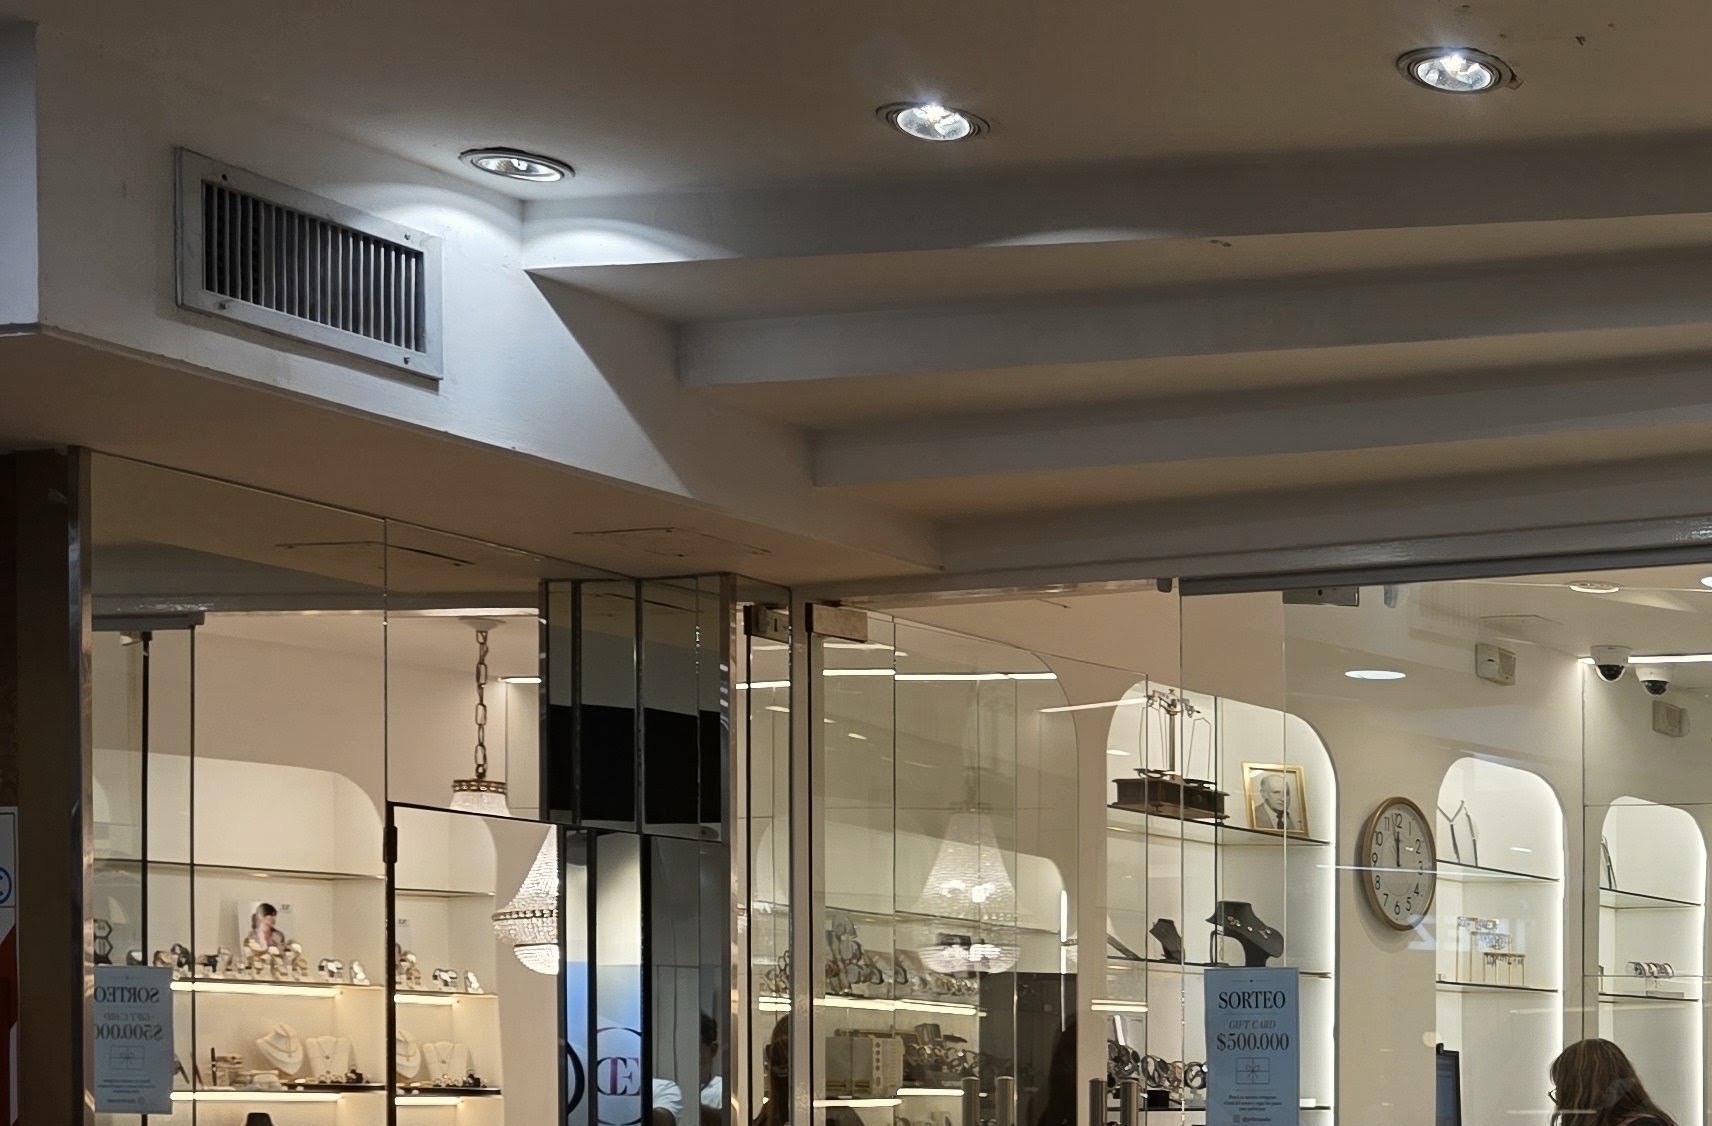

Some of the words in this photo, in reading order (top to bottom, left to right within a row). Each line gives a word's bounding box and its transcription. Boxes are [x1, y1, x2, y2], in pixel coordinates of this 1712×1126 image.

[1415, 839, 1421, 854] 2
[1375, 875, 1380, 890] 8
[1394, 901, 1400, 915] 6
[1218, 990, 1286, 1009] SORTEO
[1229, 1020, 1251, 1029] GIFT
[1252, 1020, 1276, 1029] CARD
[1216, 1033, 1289, 1051] $500.000
